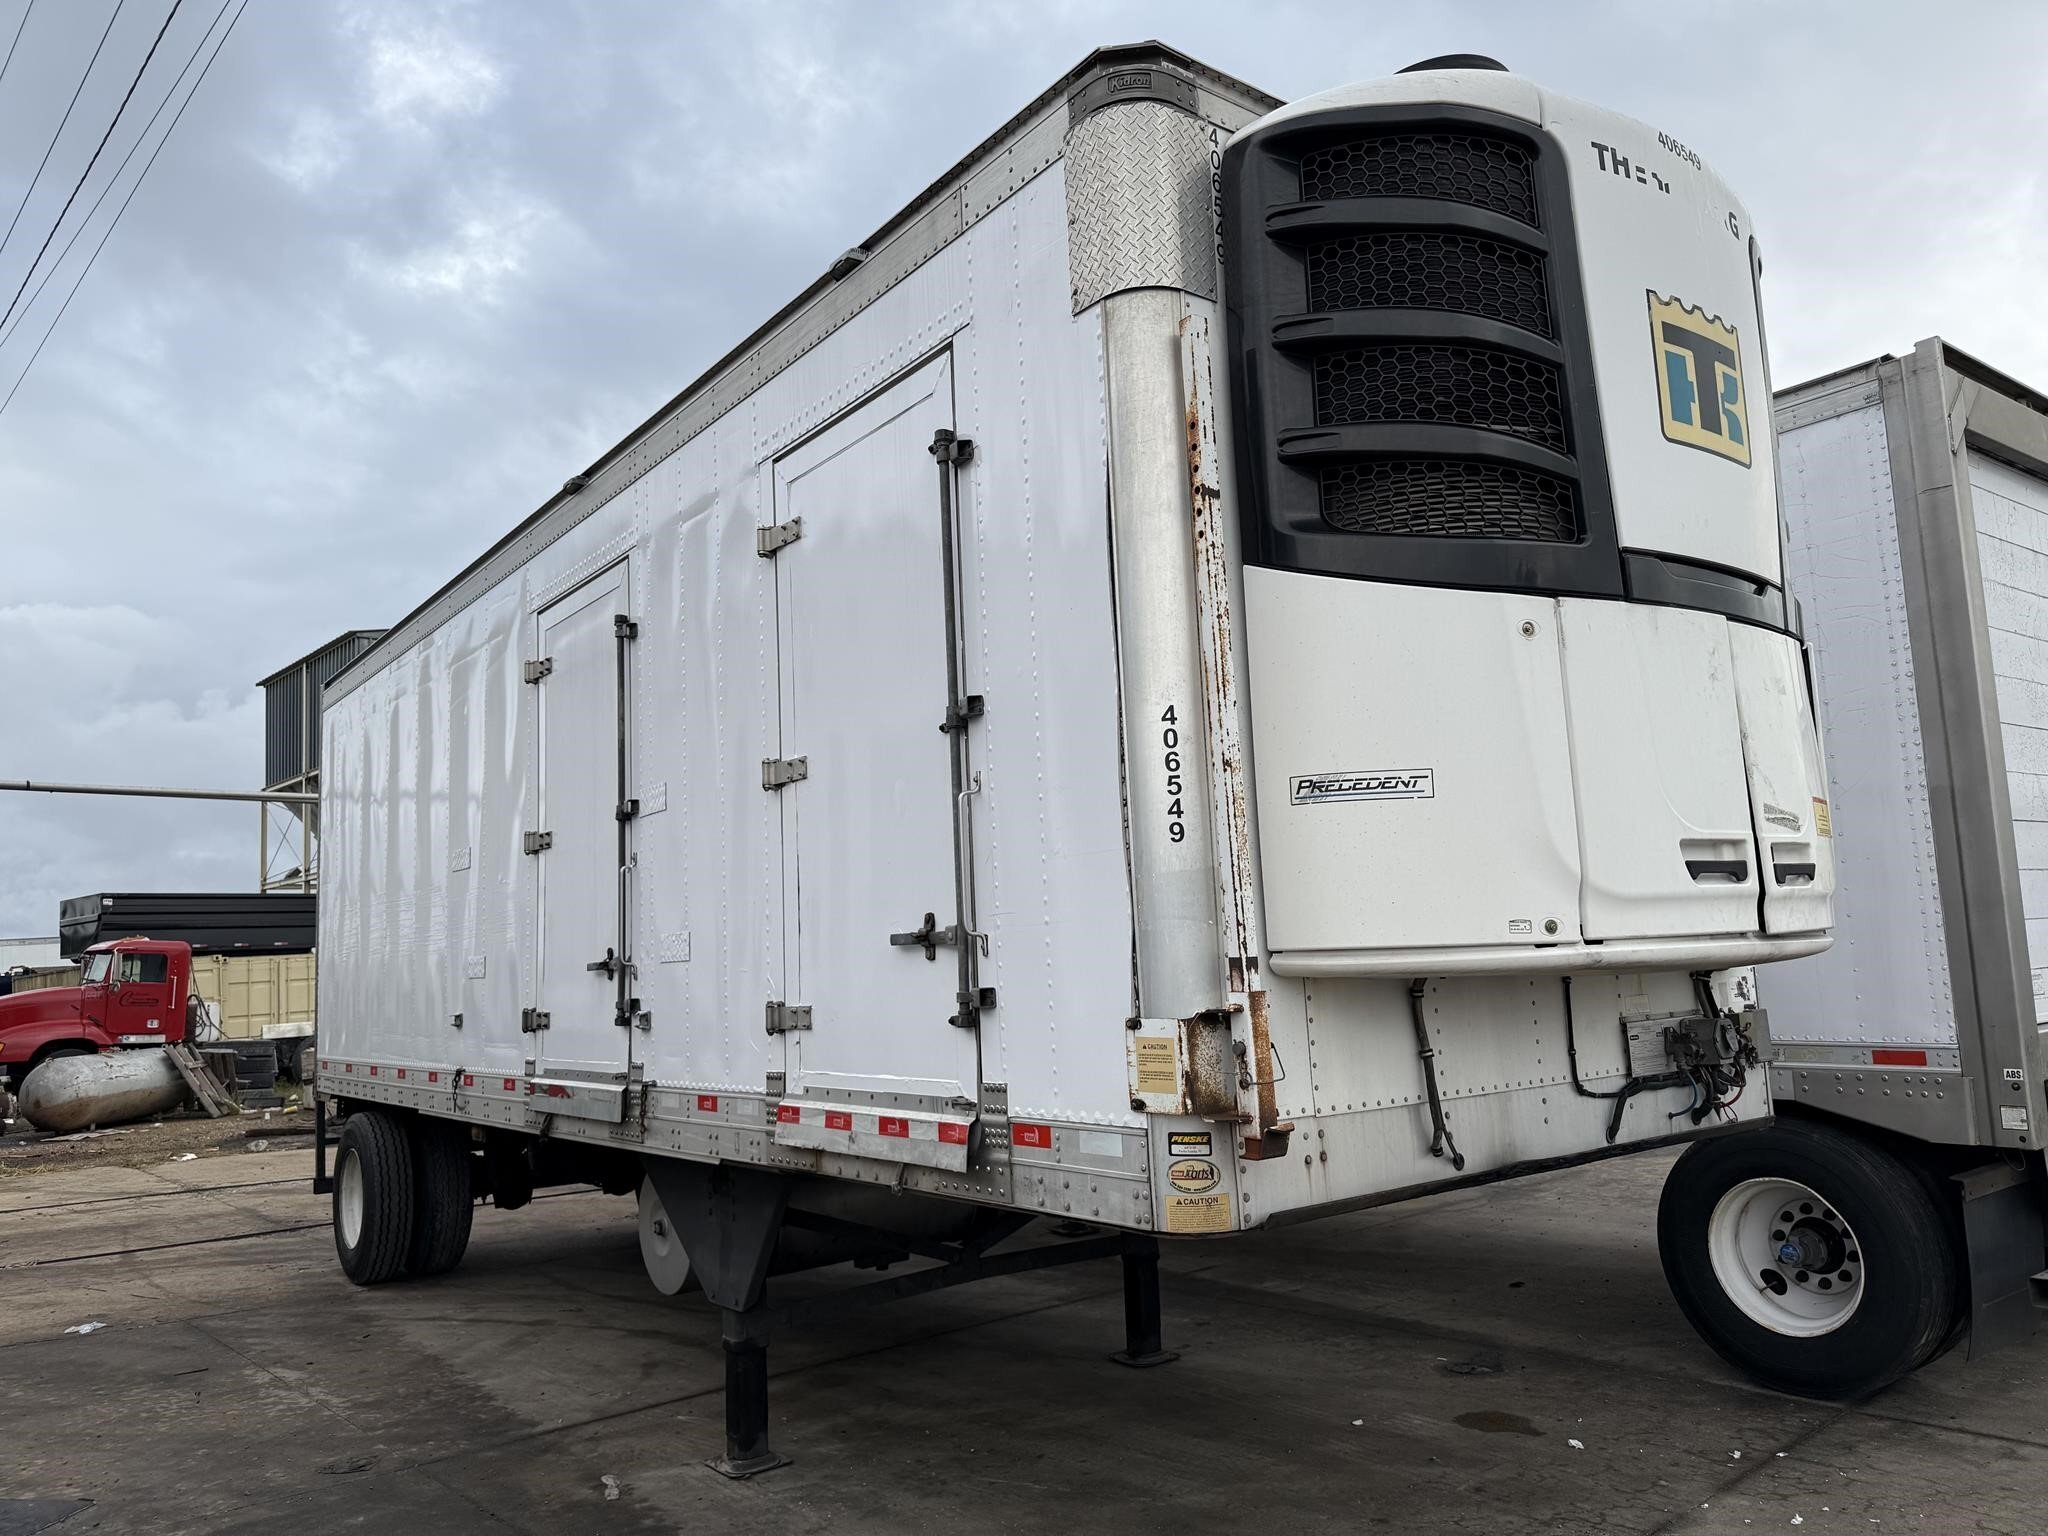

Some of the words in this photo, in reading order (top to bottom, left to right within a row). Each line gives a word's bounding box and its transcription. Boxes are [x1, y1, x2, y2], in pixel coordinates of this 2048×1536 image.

[1109, 75, 1151, 91] Kidron
[1658, 131, 1701, 170] 406549
[1161, 704, 1185, 843] 406549
[1295, 775, 1429, 796] PRECEDENT
[2005, 1070, 2022, 1079] ABS
[1171, 1135, 1210, 1143] PENSKE
[1183, 1197, 1219, 1206] CAUTION
